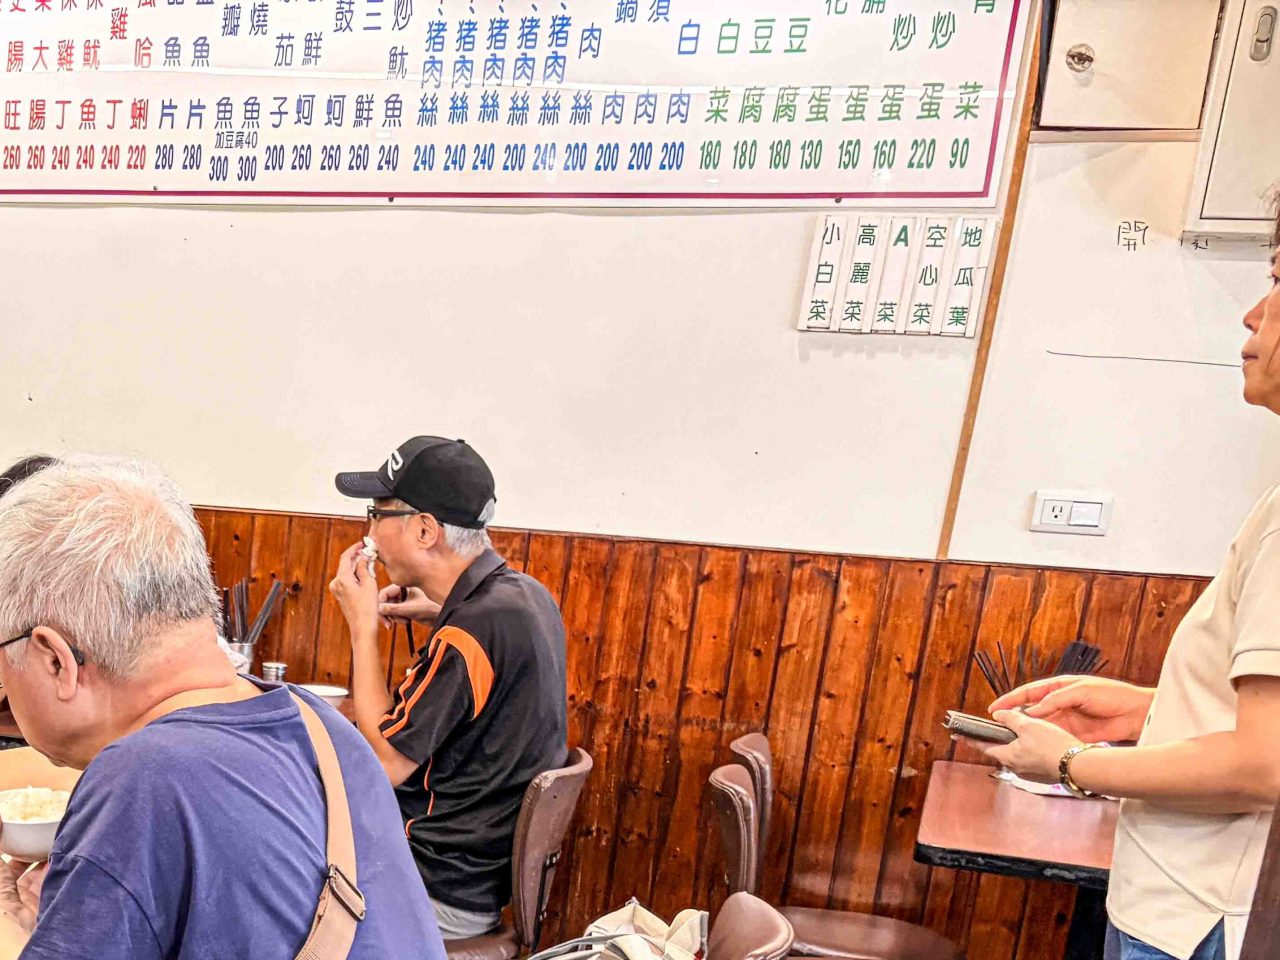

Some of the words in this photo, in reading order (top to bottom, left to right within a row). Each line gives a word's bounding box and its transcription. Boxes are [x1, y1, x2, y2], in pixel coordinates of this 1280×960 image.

[3, 145, 21, 170] 260
[27, 145, 45, 170] 260
[51, 145, 70, 170] 240
[76, 145, 95, 170] 240
[100, 145, 120, 170] 240
[127, 145, 146, 170] 220
[155, 144, 174, 170] 280
[182, 144, 203, 170] 280
[264, 145, 285, 171] 200
[291, 144, 312, 171] 260
[320, 145, 341, 171] 260
[348, 145, 370, 171] 260
[377, 144, 399, 171] 240
[413, 143, 436, 171] 240
[443, 143, 467, 171] 240
[472, 143, 495, 171] 240
[502, 143, 526, 171] 200
[563, 143, 587, 171] 200
[594, 143, 620, 171] 200
[627, 143, 653, 171] 200
[659, 142, 685, 171] 200
[699, 139, 722, 170] 180
[733, 139, 757, 170] 180
[769, 139, 791, 170] 180
[800, 139, 823, 170] 130
[837, 139, 861, 170] 150
[873, 139, 897, 170] 160
[907, 138, 937, 170] 220
[949, 137, 970, 168] 90
[209, 156, 229, 182] 300
[237, 156, 257, 182] 300
[807, 222, 841, 322] 小白菜
[842, 223, 878, 323] 高麗菜
[911, 224, 947, 325] 空心菜
[948, 226, 983, 327] 地瓜葉
